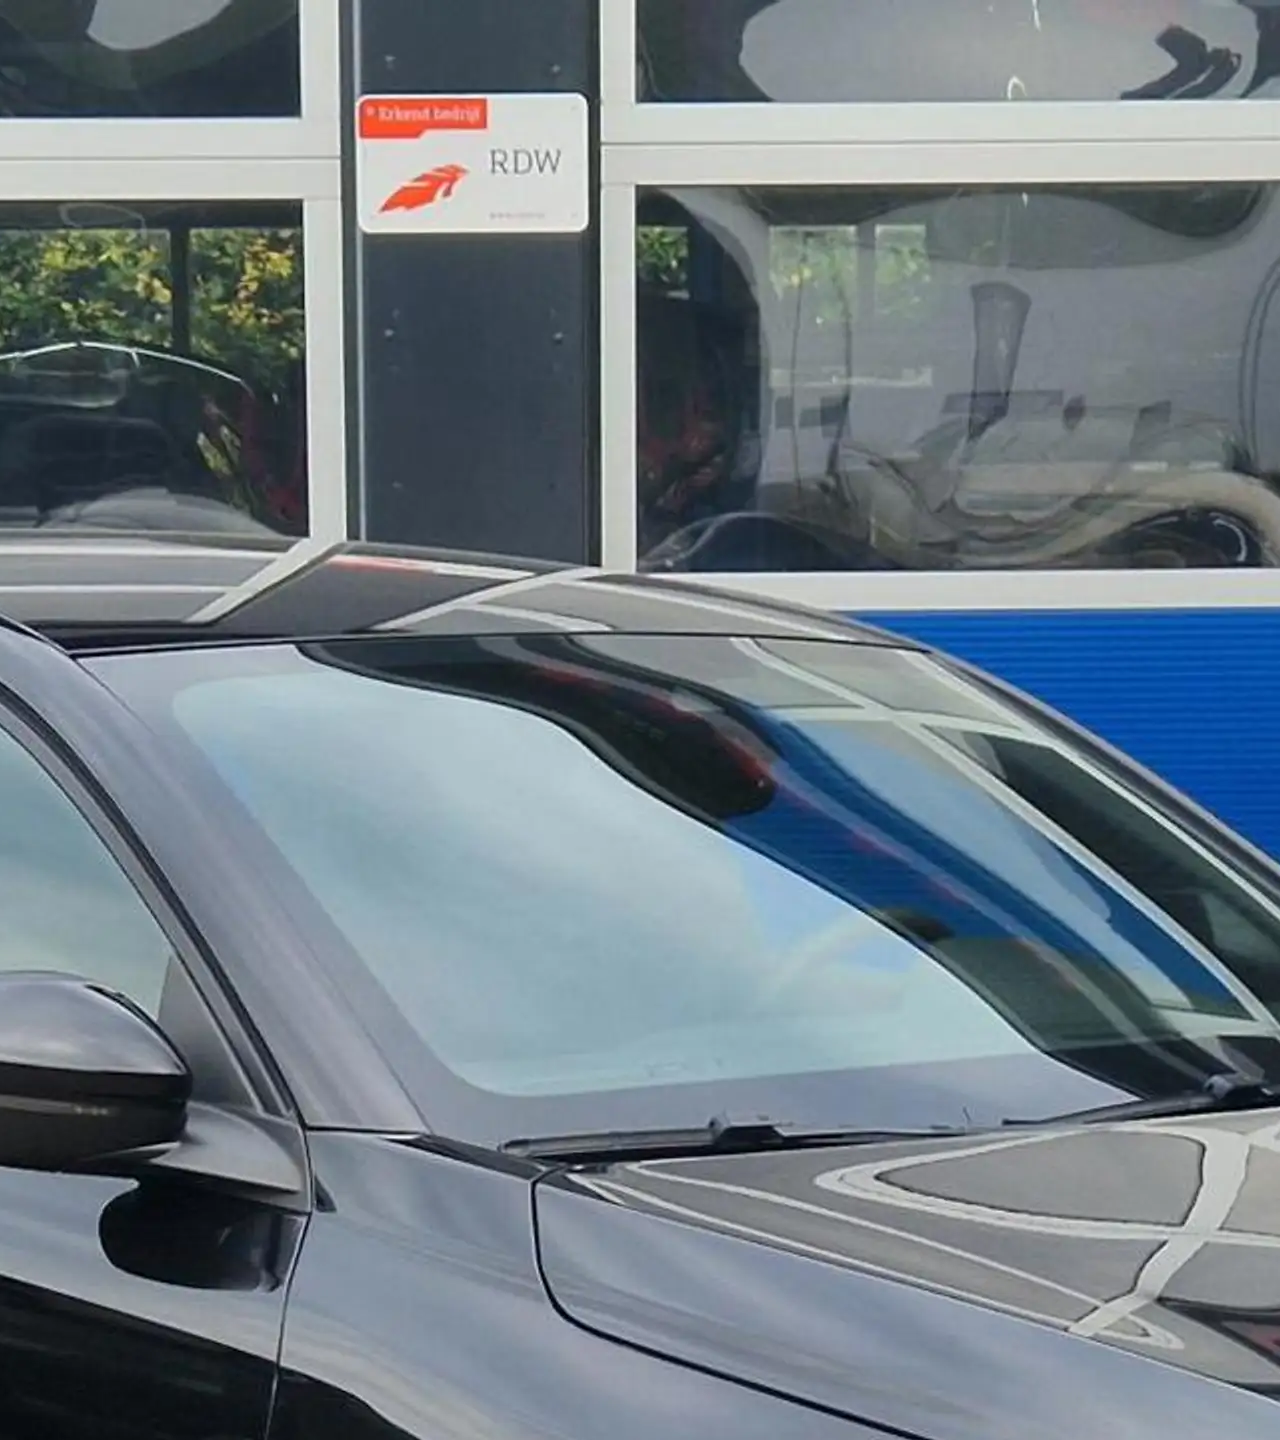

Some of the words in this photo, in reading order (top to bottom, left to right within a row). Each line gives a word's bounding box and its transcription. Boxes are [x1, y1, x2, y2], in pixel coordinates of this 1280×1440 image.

[377, 105, 430, 121] Erkend
[433, 104, 480, 124] bedrijf
[489, 148, 562, 175] RDW
